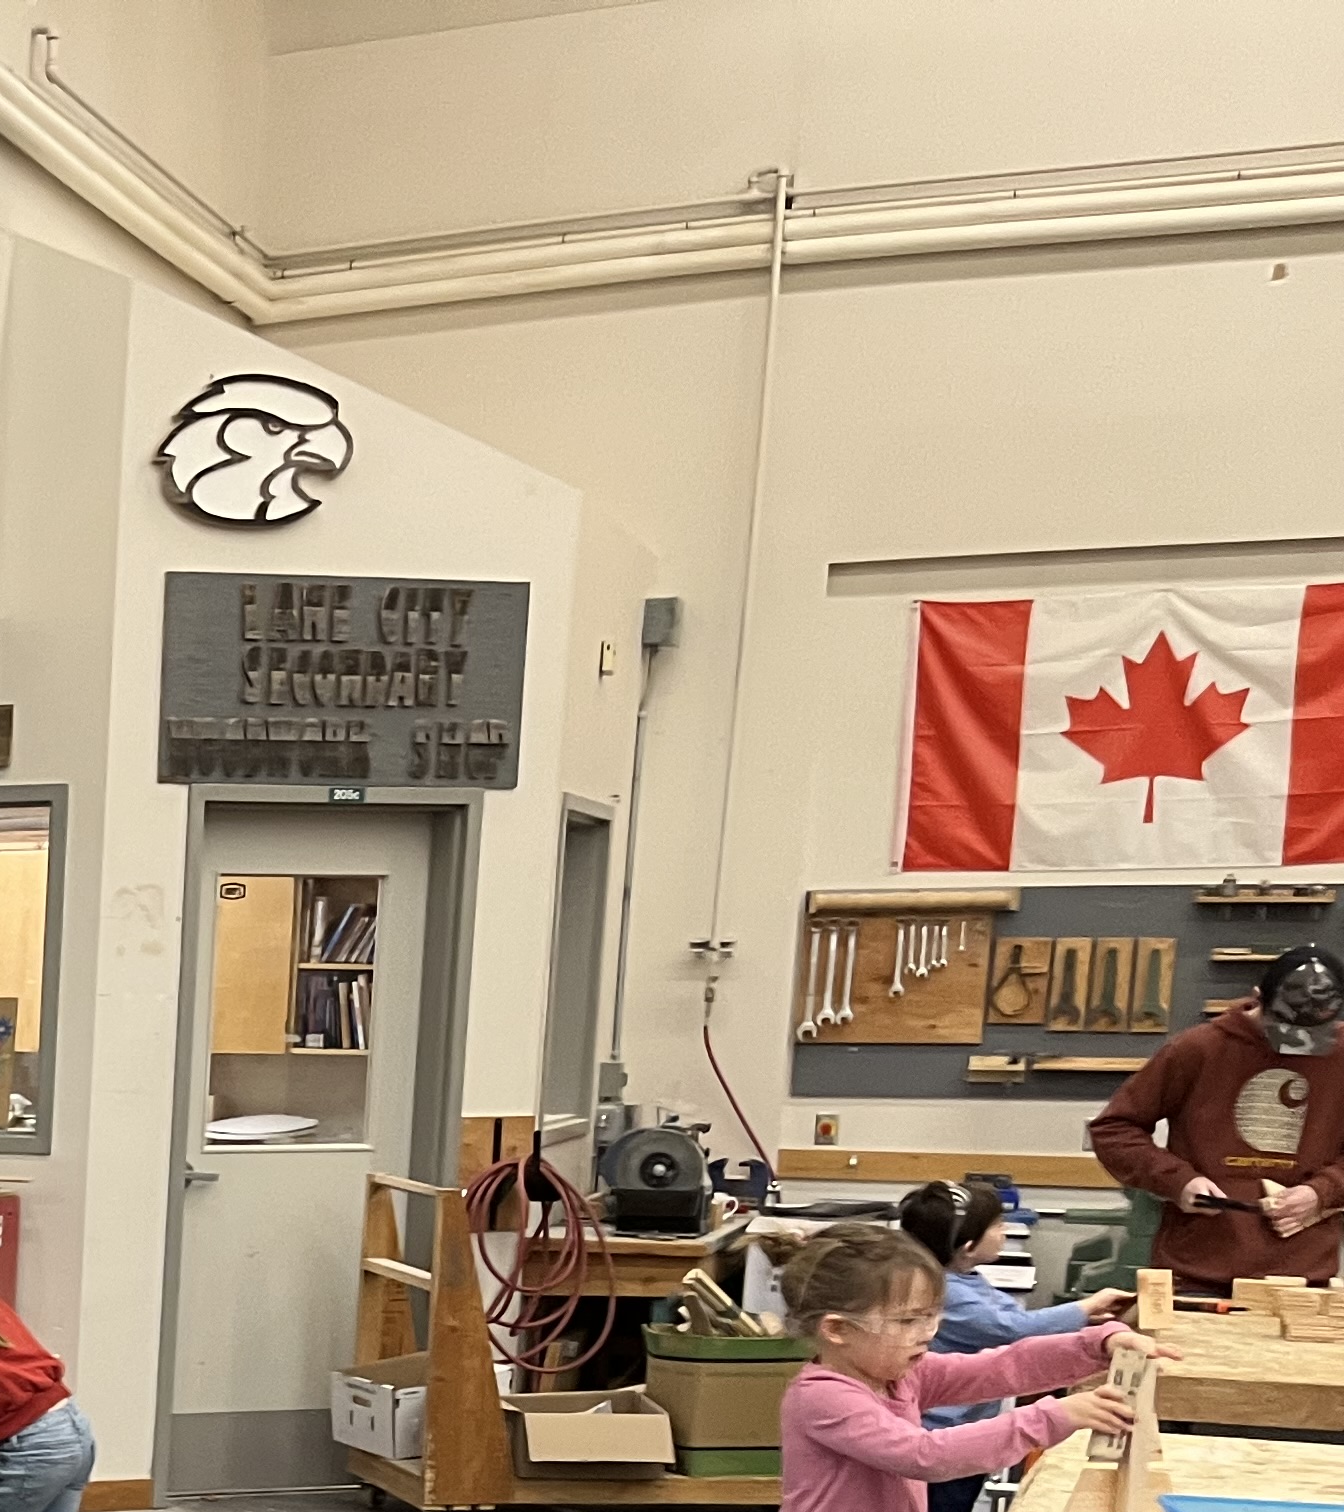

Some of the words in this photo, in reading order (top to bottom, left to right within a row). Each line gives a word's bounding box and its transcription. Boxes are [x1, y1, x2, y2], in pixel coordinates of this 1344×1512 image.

[240, 582, 353, 643] LAKE
[377, 585, 475, 649] CITY
[241, 645, 469, 708] SECONDARY
